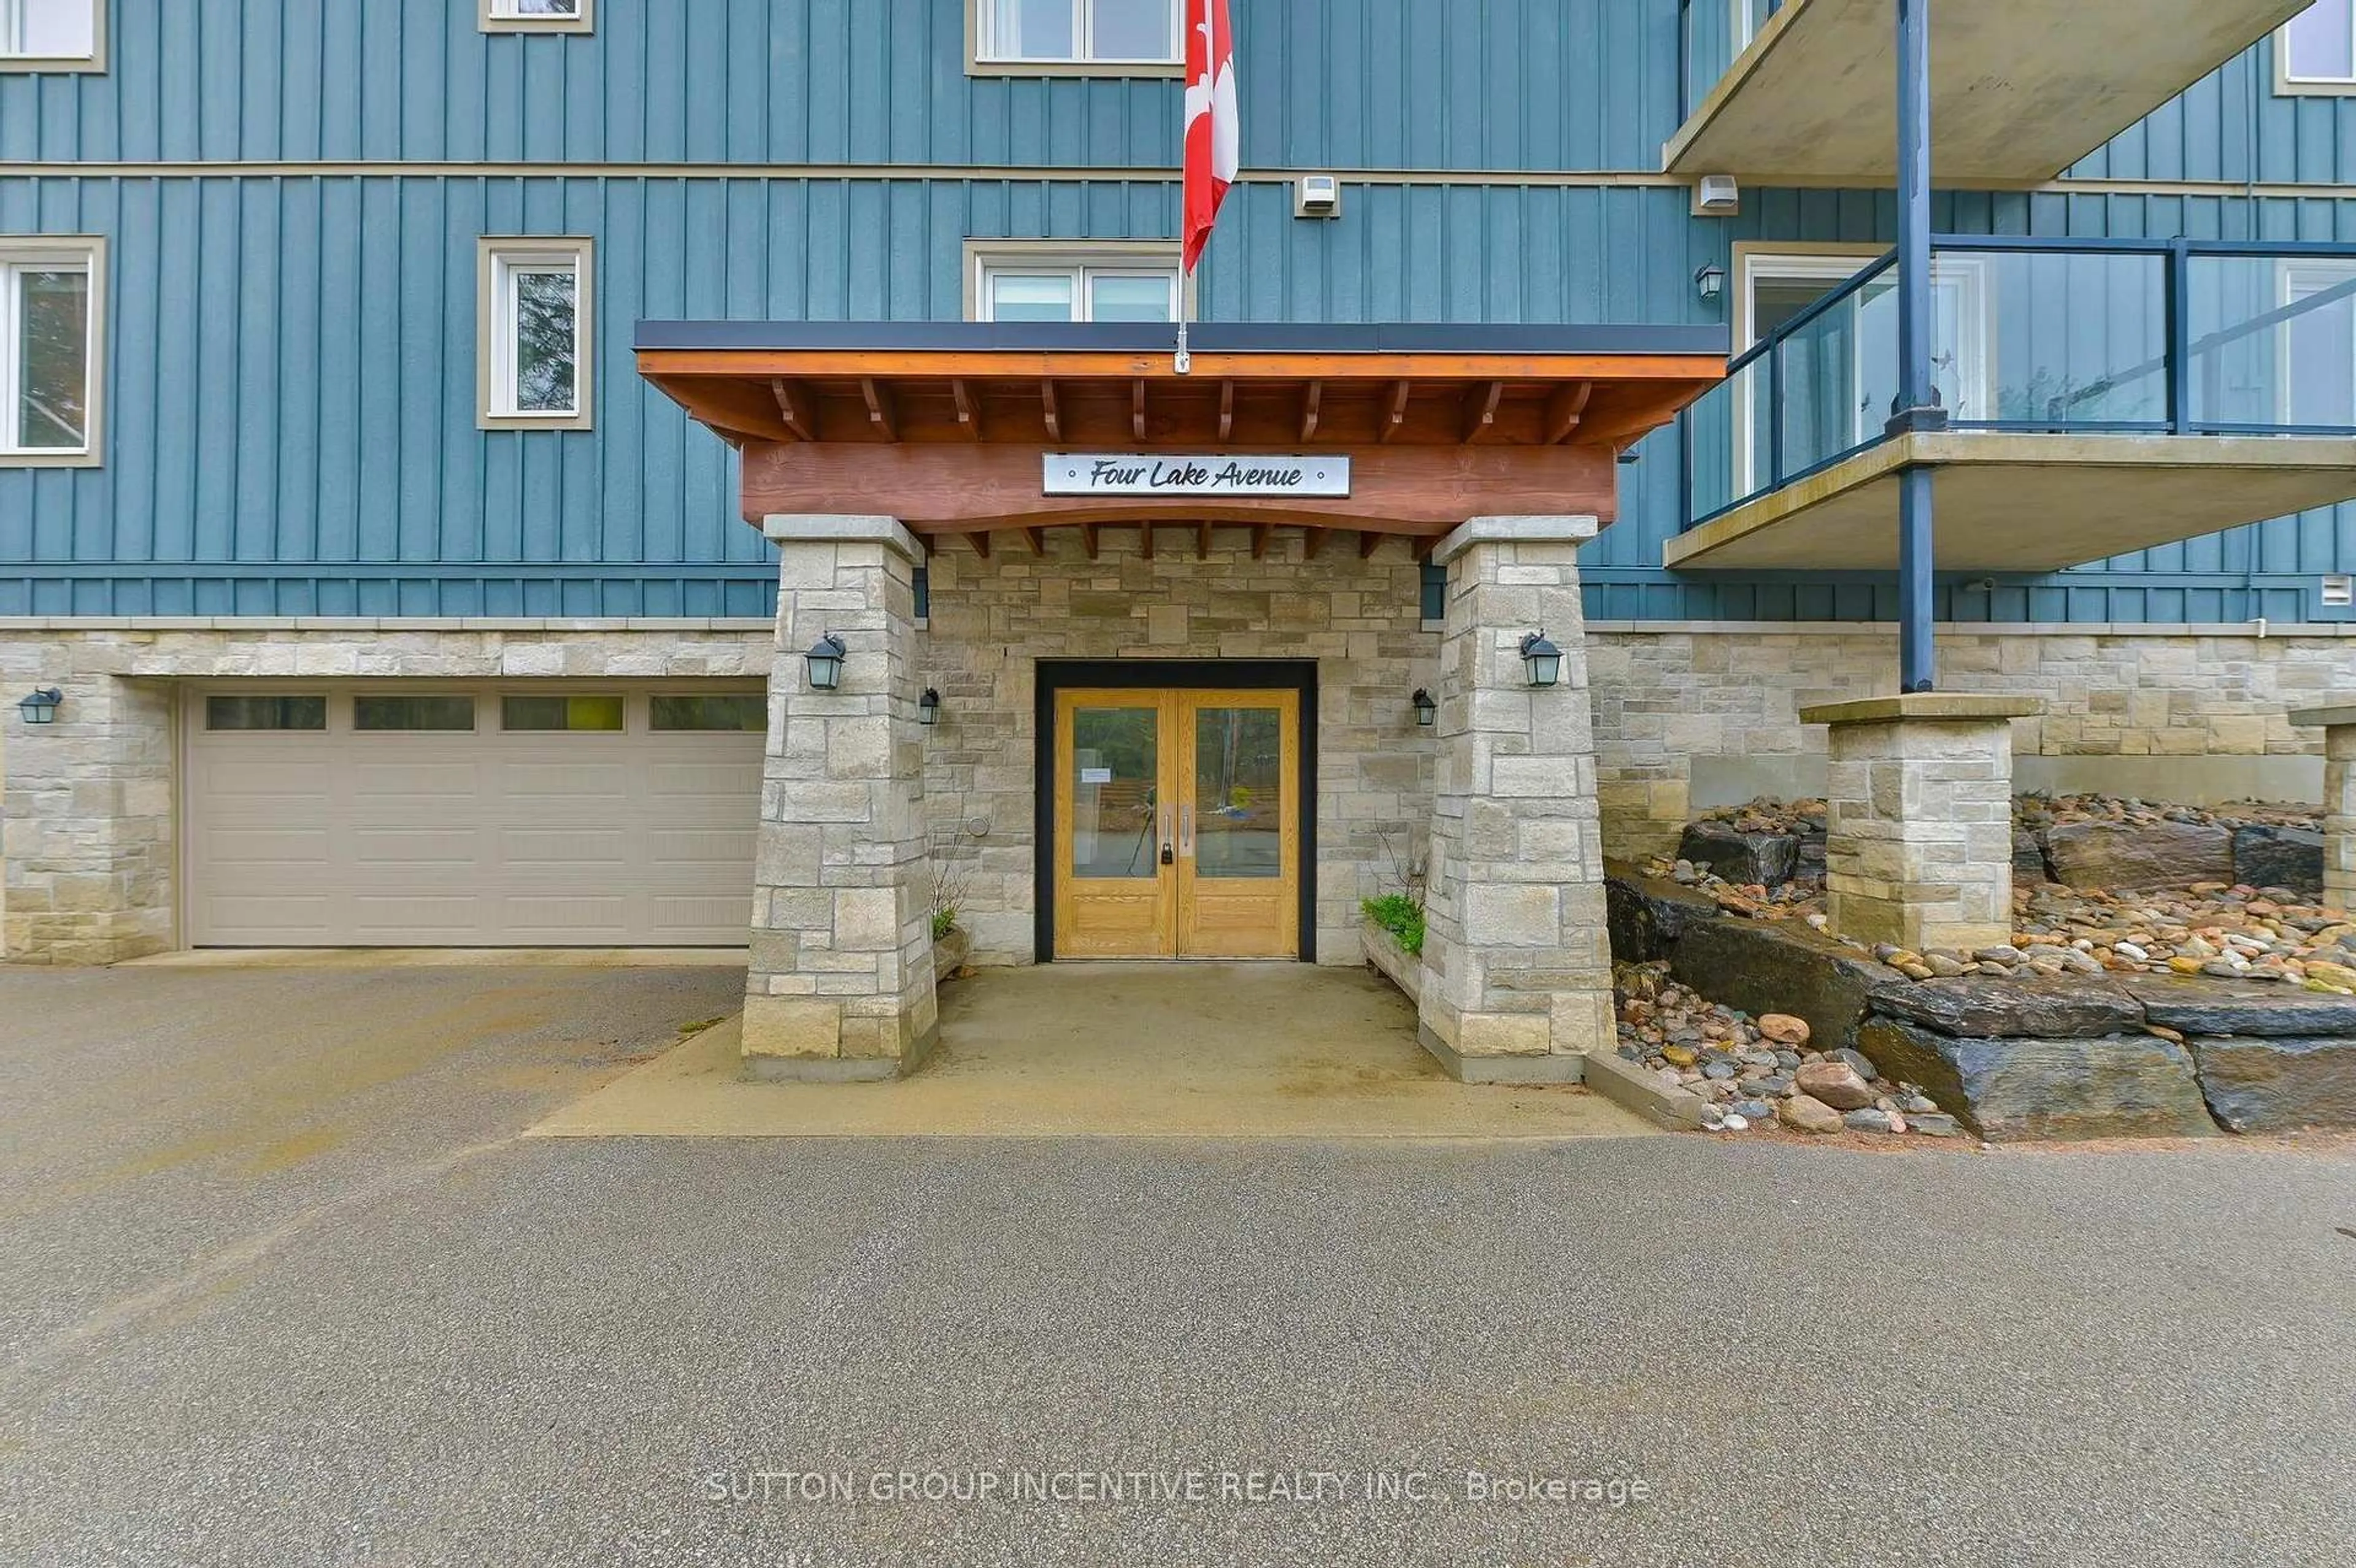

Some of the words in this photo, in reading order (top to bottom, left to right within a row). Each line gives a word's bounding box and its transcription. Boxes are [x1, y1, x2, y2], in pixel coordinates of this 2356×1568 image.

[1091, 460, 1145, 487] Four
[1150, 461, 1209, 487] Lake
[1212, 461, 1303, 487] Avenue
